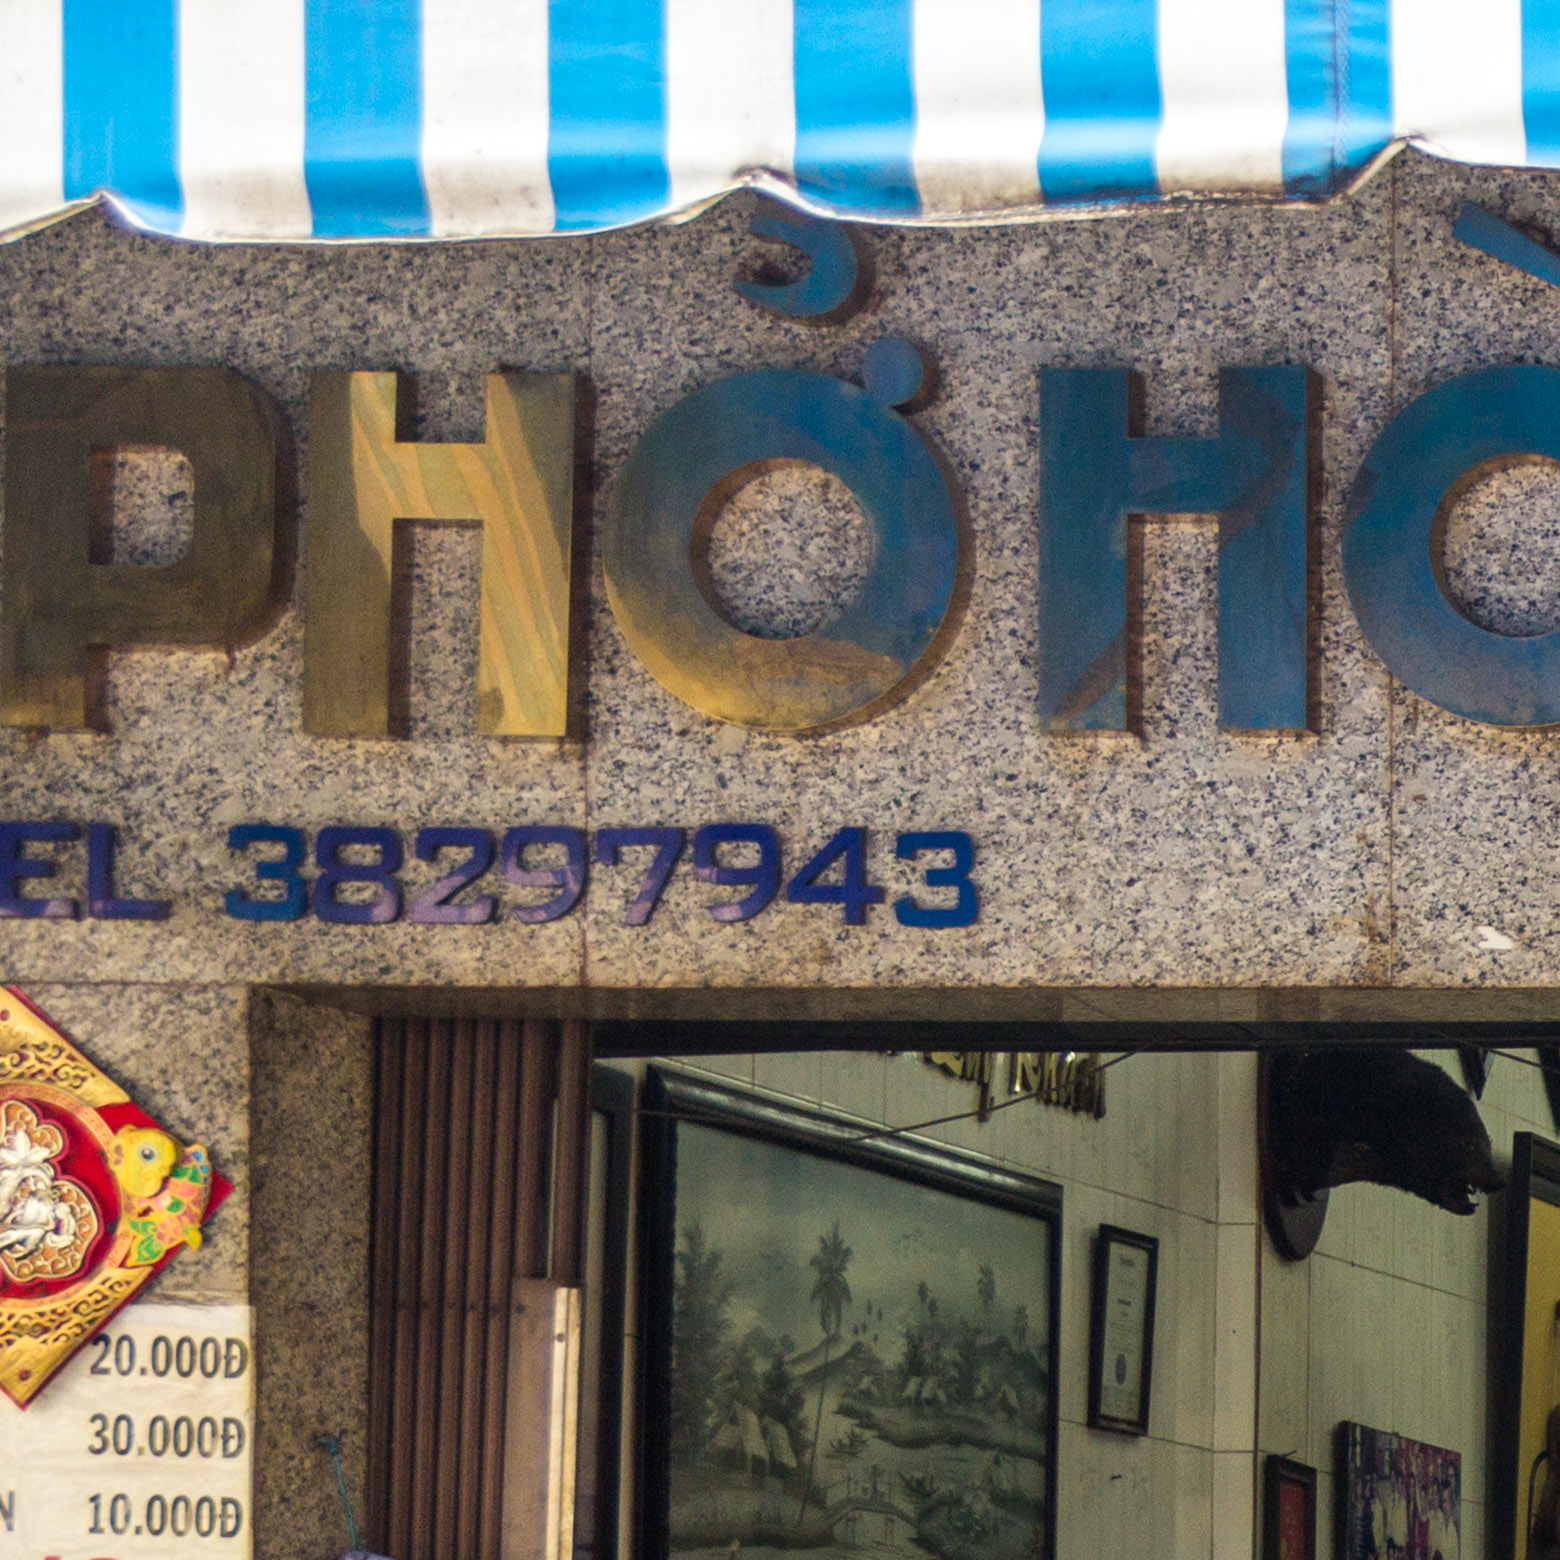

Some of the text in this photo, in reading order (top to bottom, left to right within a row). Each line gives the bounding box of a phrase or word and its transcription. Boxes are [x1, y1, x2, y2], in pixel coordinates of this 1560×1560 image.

[0, 202, 960, 735] PHỞ
[226, 824, 977, 926] 38297943
[88, 1331, 249, 1378] 20.000Đ
[88, 1413, 245, 1458] 30.000Đ
[89, 1493, 243, 1538] 10.000Đ
